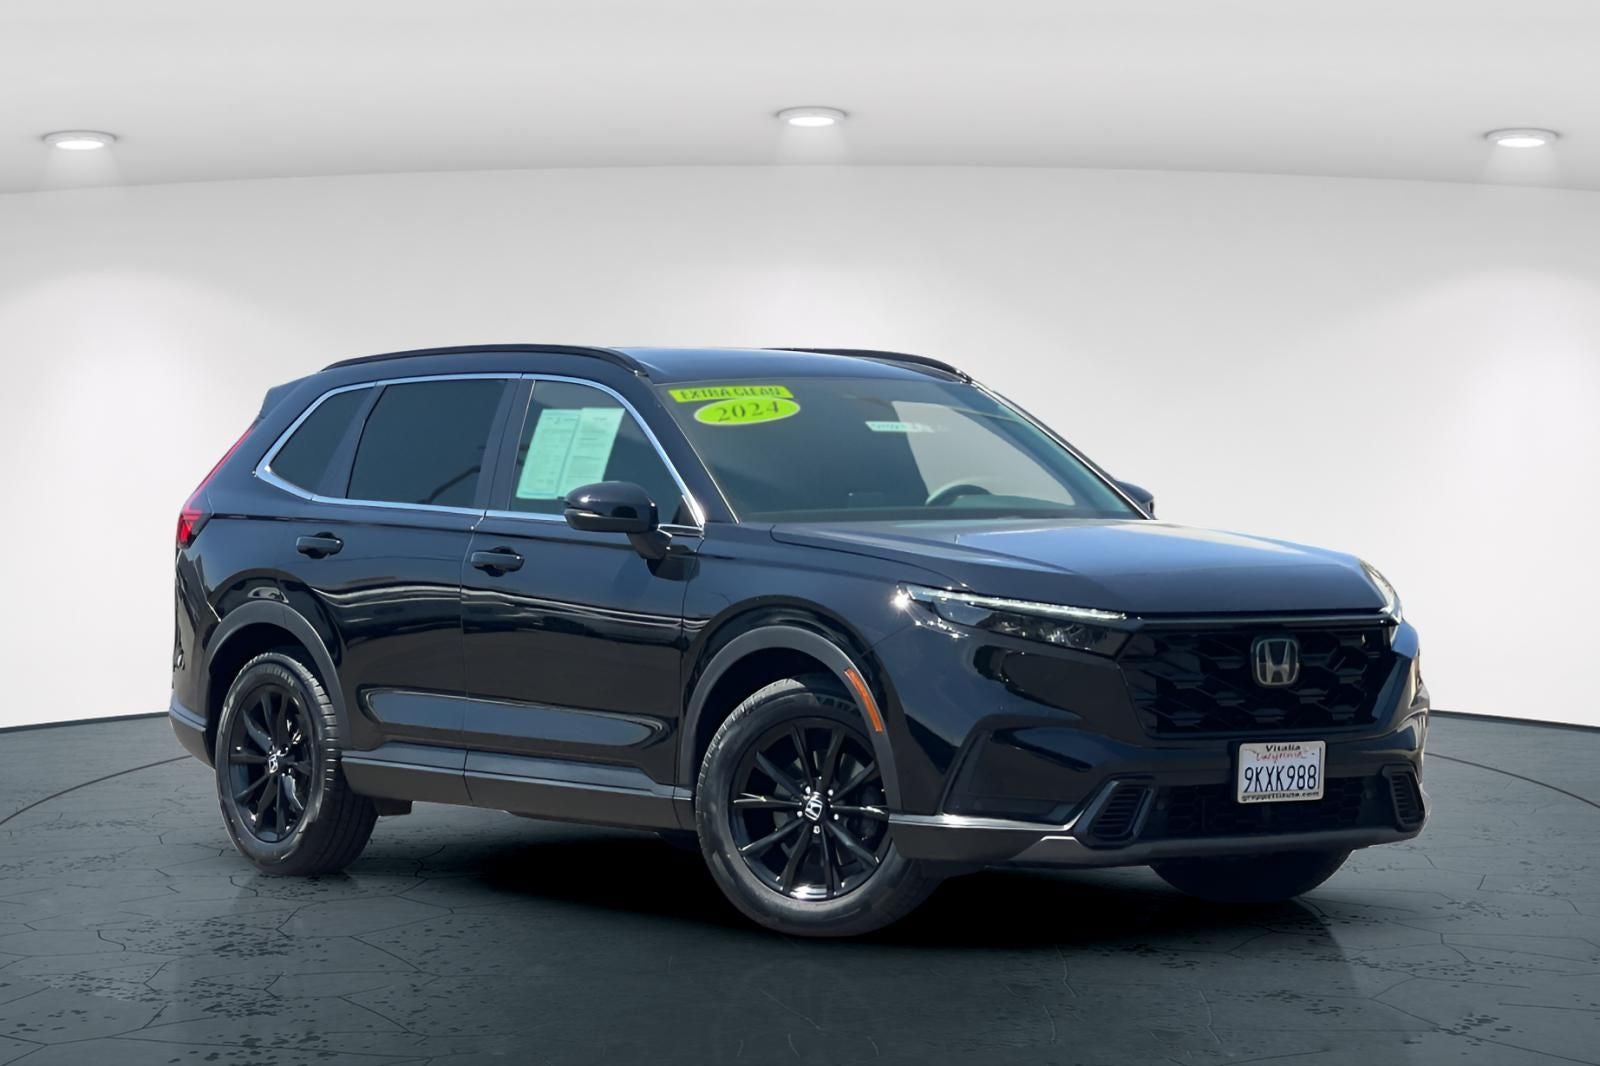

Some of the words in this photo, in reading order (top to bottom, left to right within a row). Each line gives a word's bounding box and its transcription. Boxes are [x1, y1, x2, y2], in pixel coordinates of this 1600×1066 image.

[681, 389, 730, 400] EXTRA
[733, 386, 781, 397] CLEAN
[715, 401, 779, 422] 2024
[1243, 764, 1317, 793] 9KXK988
